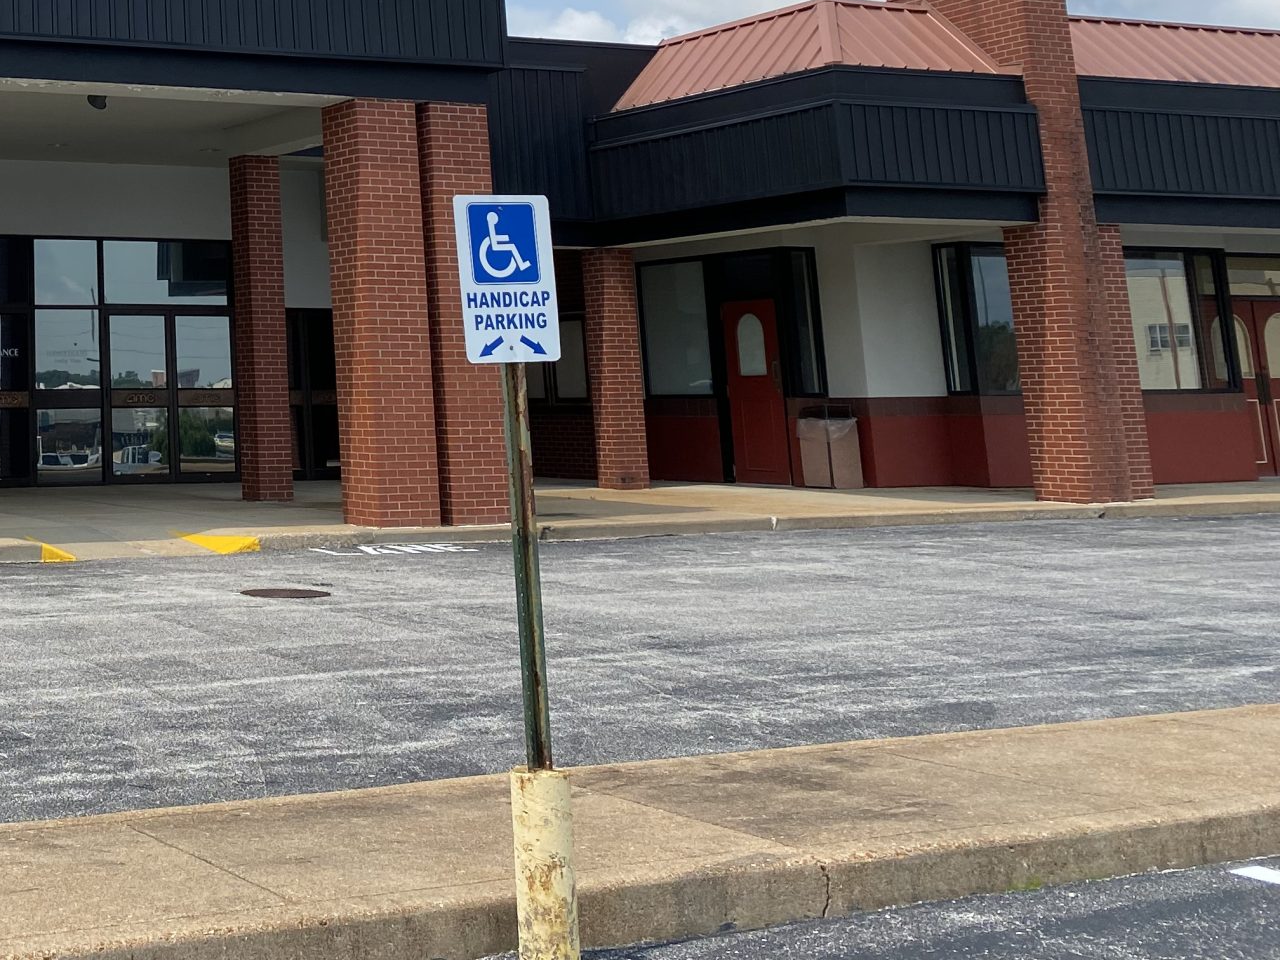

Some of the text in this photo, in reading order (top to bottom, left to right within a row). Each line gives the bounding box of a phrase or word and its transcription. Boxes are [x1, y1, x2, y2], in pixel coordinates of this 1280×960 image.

[467, 290, 550, 309] HANDICAP
[474, 313, 548, 331] PARKING
[308, 543, 479, 556] LANE
